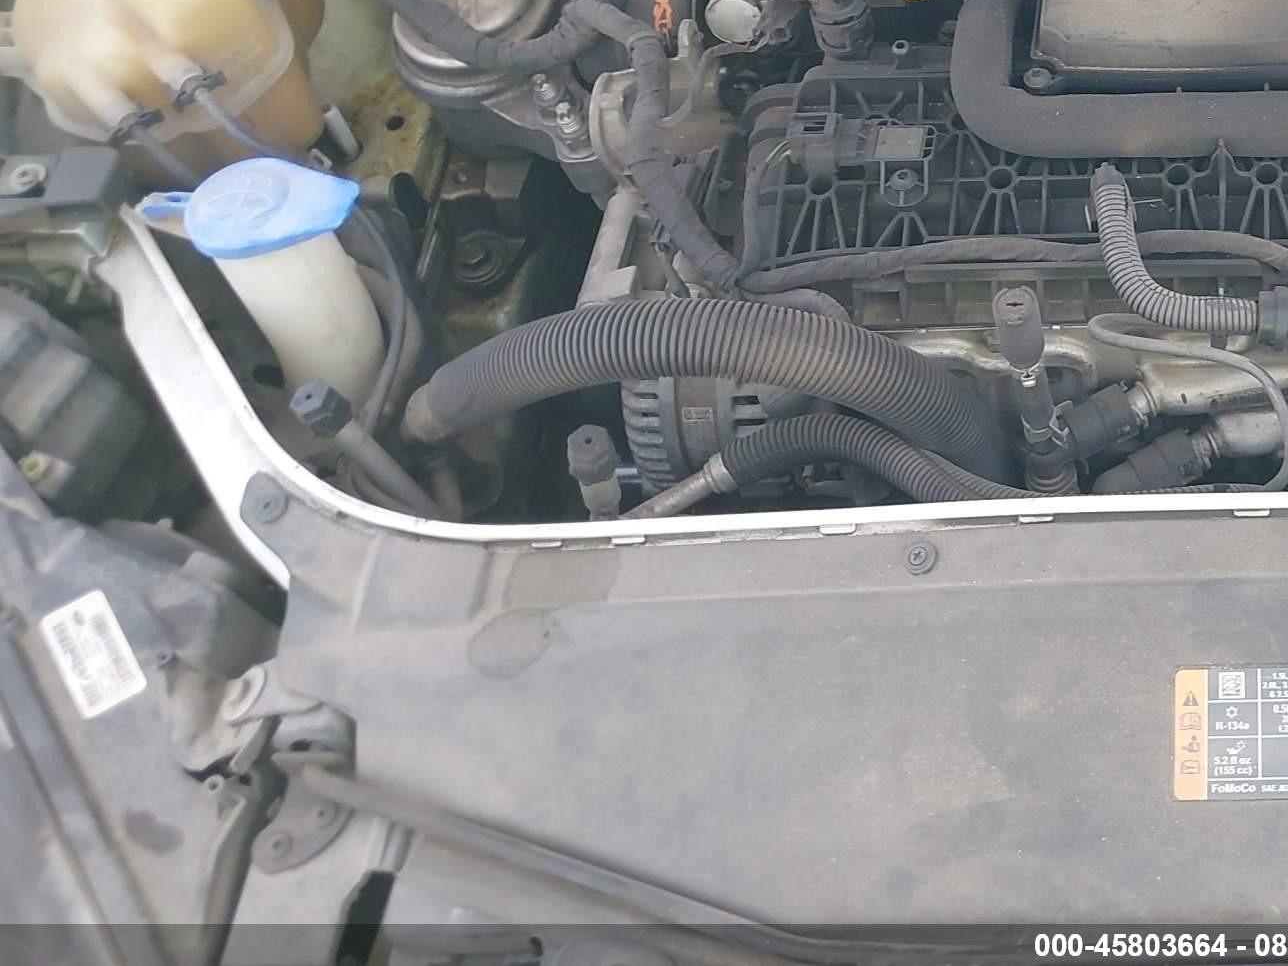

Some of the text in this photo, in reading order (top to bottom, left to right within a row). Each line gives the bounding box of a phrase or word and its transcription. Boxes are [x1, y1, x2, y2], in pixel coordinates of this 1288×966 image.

[1215, 721, 1250, 731] R-134a
[1214, 756, 1229, 765] 5.2
[1239, 757, 1252, 765] oz
[1214, 765, 1253, 777] (155 cc)
[1211, 783, 1257, 793] FoMoCo
